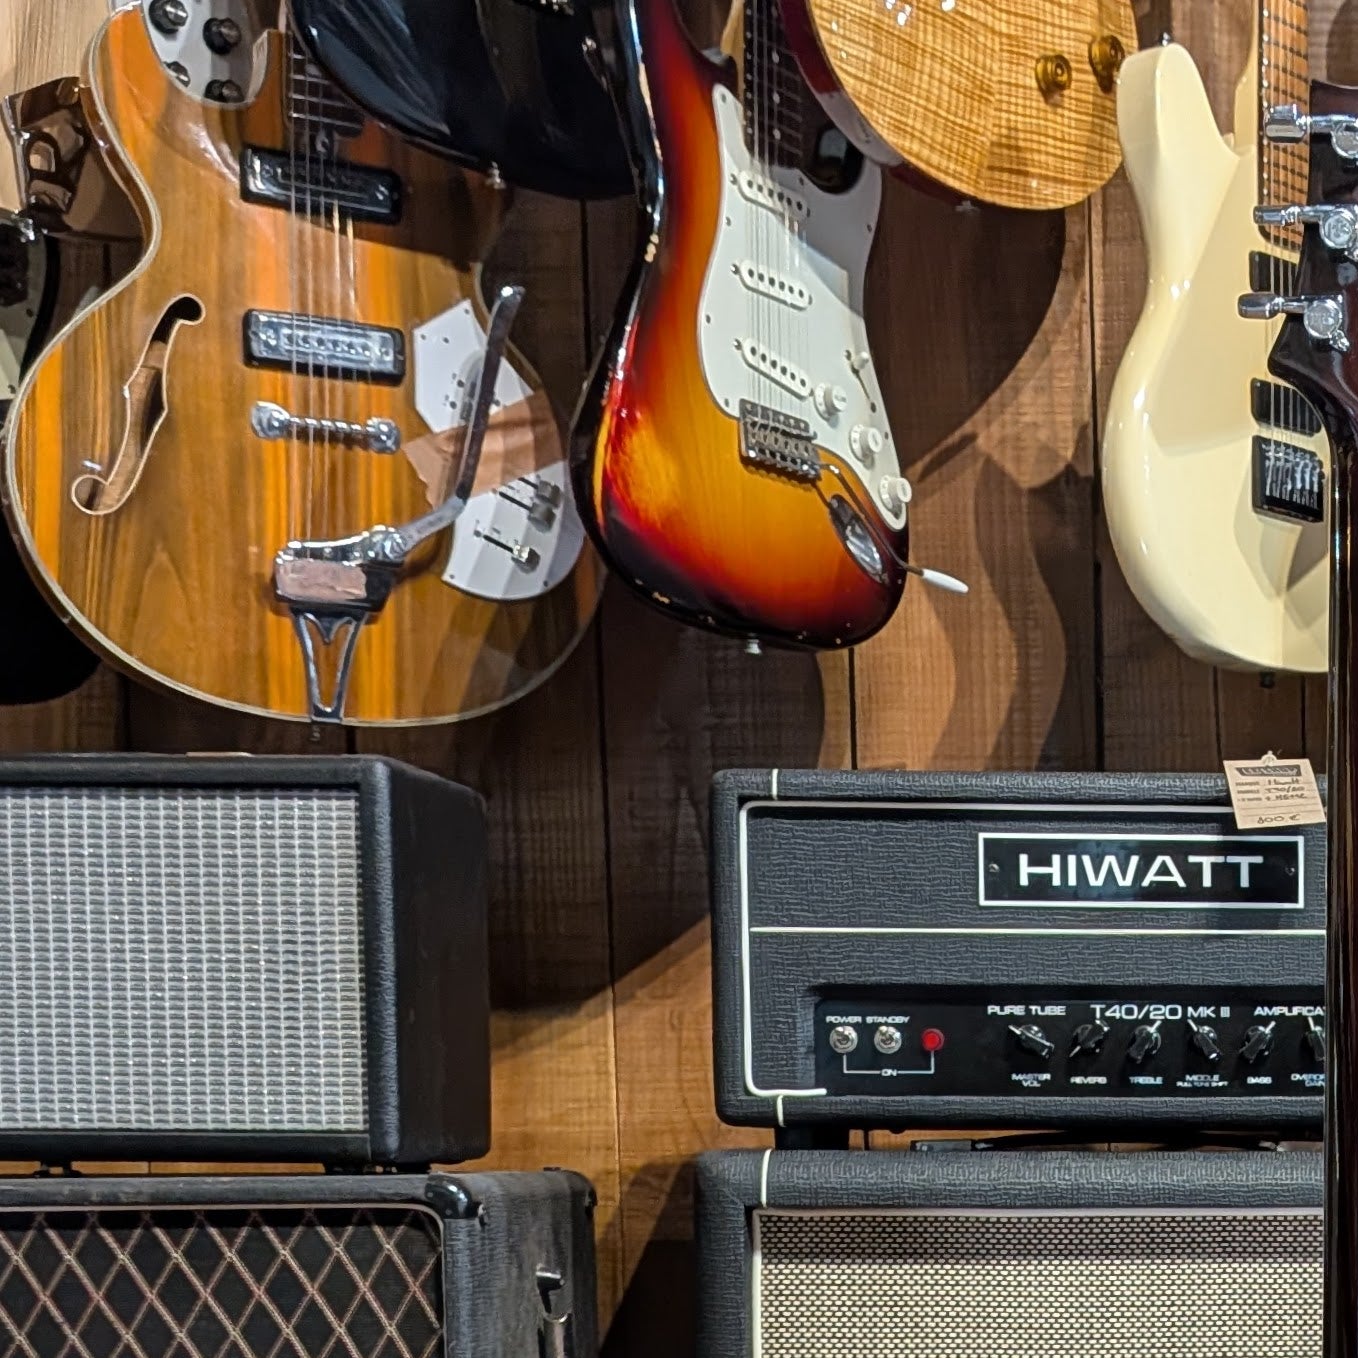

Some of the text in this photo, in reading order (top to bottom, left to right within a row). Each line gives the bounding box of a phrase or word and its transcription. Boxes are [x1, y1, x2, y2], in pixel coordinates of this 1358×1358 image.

[1019, 853, 1264, 888] HIWATT
[987, 1005, 1026, 1016] PURE
[1029, 1005, 1067, 1016] TUBE
[1090, 1004, 1182, 1020] T40/20
[1187, 1006, 1216, 1018] MK
[825, 1016, 910, 1024] POWER STANDBY
[881, 1068, 898, 1077] ON
[1011, 1073, 1051, 1081] MASTER
[1022, 1080, 1041, 1088] VOL
[1070, 1076, 1107, 1085] REVERB
[1129, 1076, 1163, 1085] TREBLE
[1247, 1076, 1272, 1084] BASS
